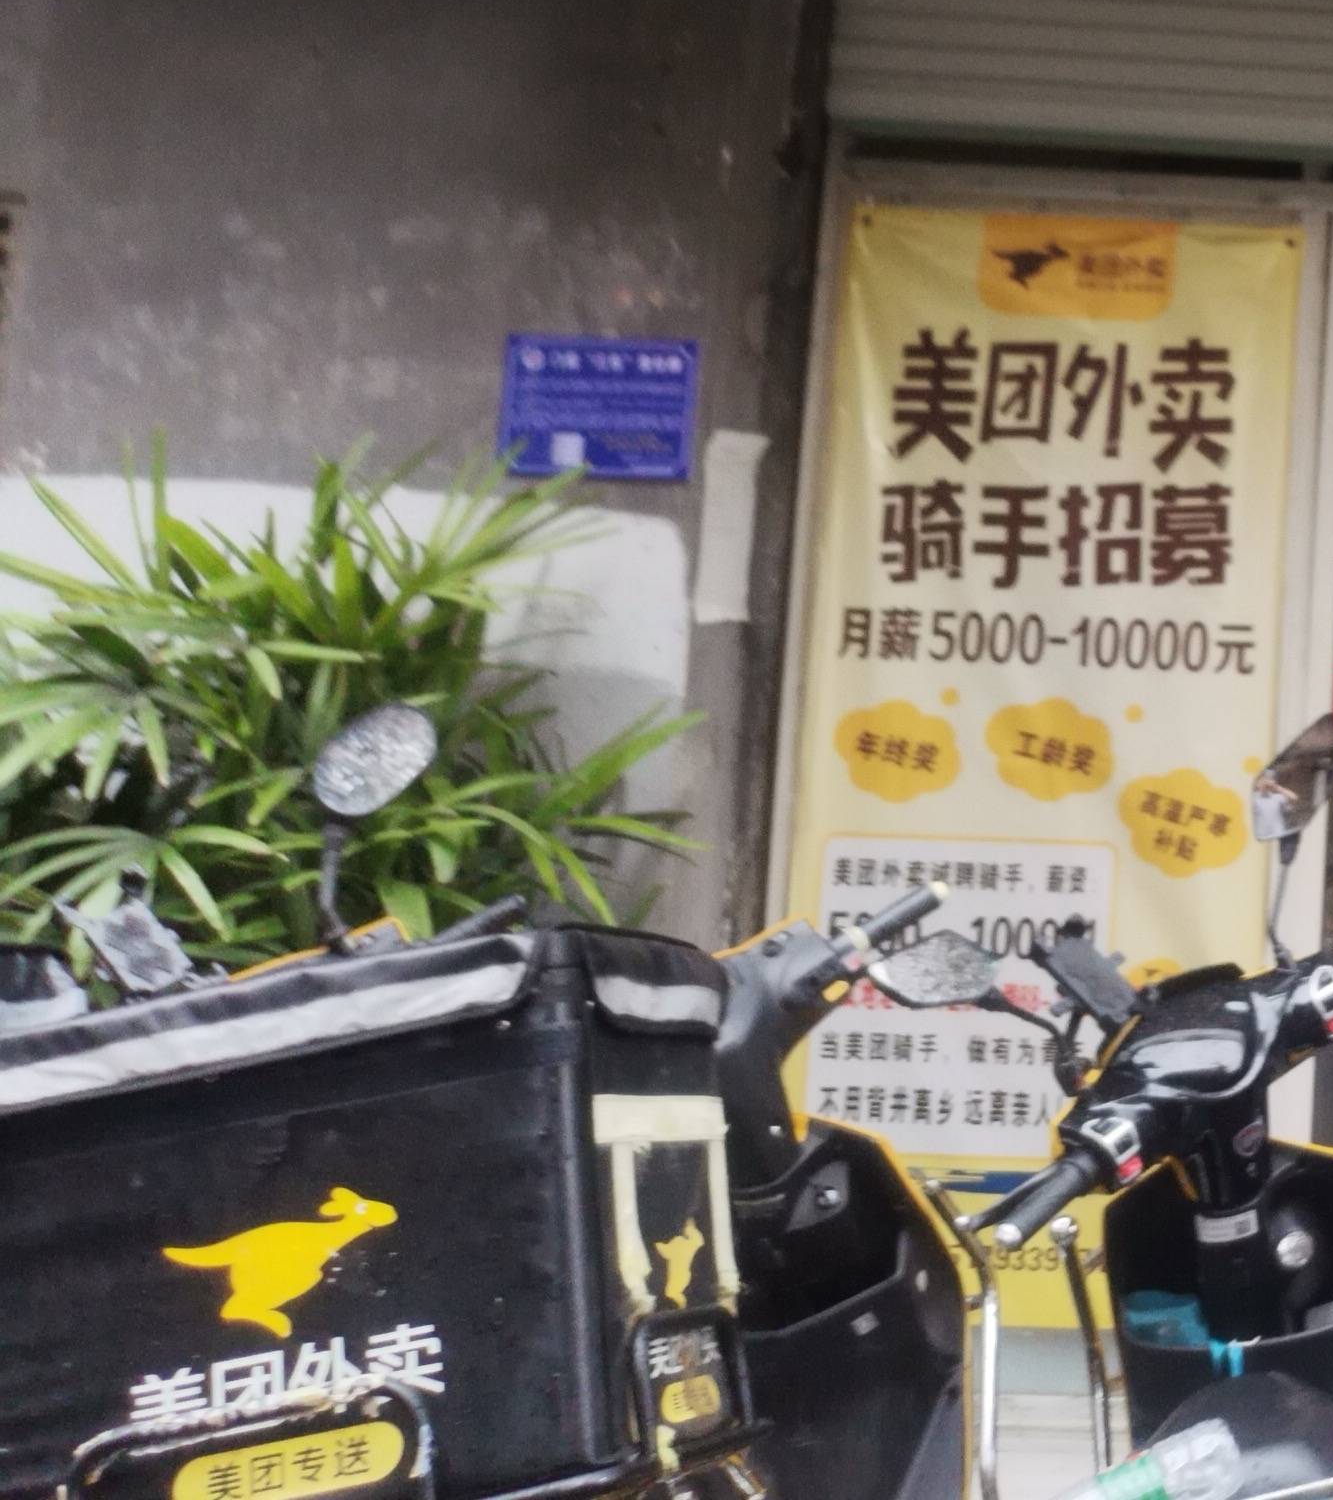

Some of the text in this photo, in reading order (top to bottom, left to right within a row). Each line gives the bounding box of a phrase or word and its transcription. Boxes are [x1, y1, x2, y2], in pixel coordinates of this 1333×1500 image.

[890, 328, 1236, 473] 美团外卖
[880, 479, 1233, 589] 骑手招募
[838, 606, 1256, 675] 月薪5000-10000元
[856, 730, 940, 775] 年终奖
[1012, 730, 1098, 777] 工龄奖
[129, 1323, 446, 1424] 美团外卖
[206, 1436, 371, 1500] 美团专送
